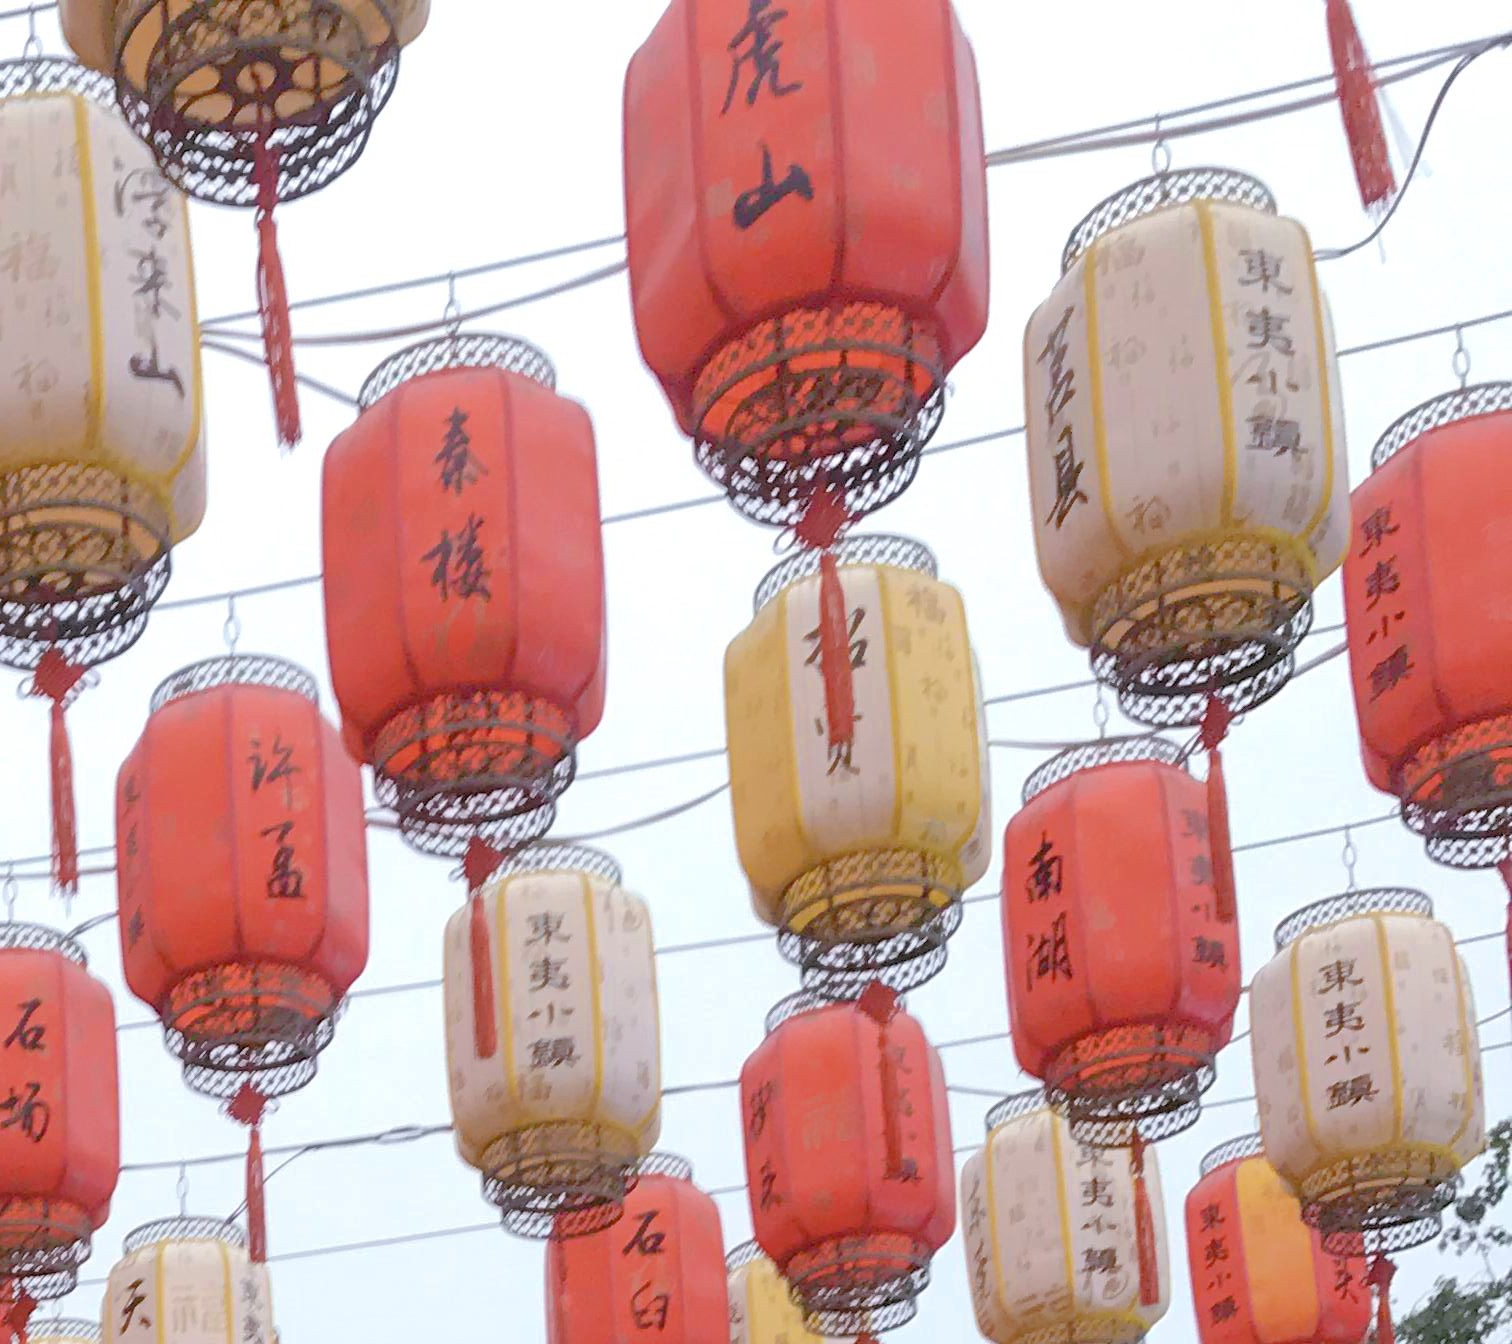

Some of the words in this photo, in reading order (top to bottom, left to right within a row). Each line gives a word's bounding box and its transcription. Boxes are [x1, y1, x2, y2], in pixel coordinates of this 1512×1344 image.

[719, 0, 816, 231] 虎山
[1237, 247, 1309, 462] 東夷小鎮
[1359, 505, 1415, 704] 東夷小鎮
[523, 910, 582, 1072] 東夷小鎮
[1025, 831, 1073, 993] 南湖
[1318, 957, 1381, 1112] 東夷小鎮
[622, 1208, 671, 1333] 石臼
[1075, 1143, 1124, 1278] 東夷小鎮
[1200, 1201, 1240, 1327] 東夷小鎮
